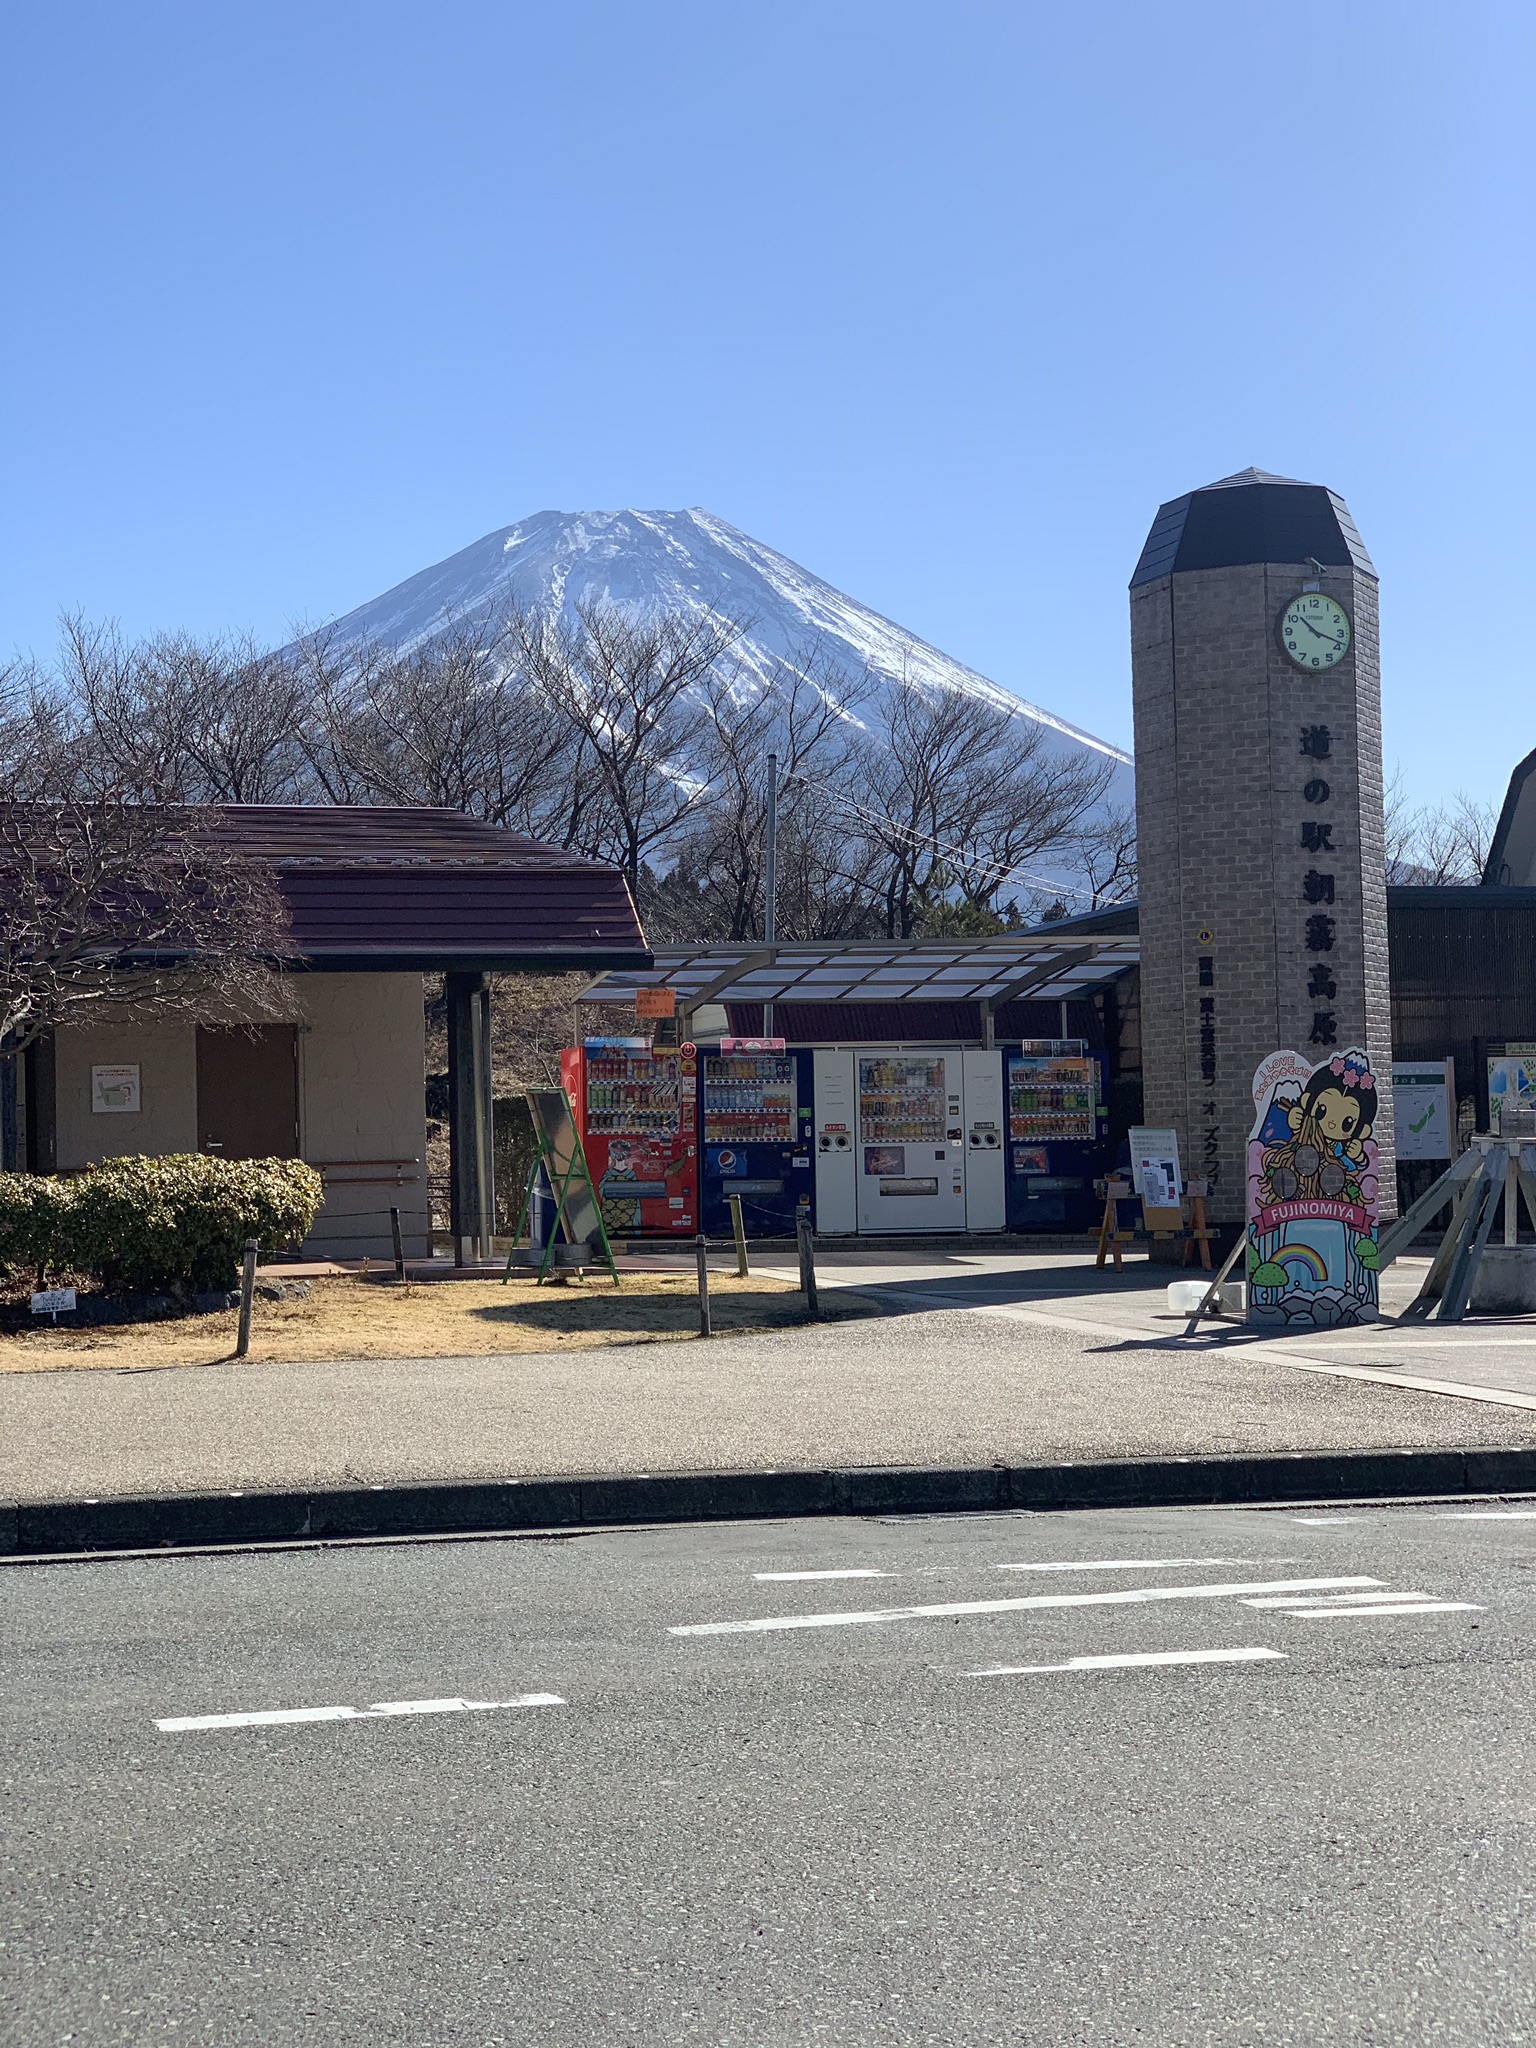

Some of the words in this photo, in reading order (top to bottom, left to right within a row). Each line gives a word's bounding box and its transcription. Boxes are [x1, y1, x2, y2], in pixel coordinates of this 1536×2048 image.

[1296, 603, 1306, 613] 11
[1309, 599, 1320, 609] 12
[1287, 614, 1299, 623] 10
[1333, 615, 1340, 624] 2
[1284, 627, 1293, 636] 9
[1336, 629, 1345, 638] 3
[1288, 641, 1297, 650] 8
[1332, 643, 1341, 651] 4
[1298, 652, 1307, 661] 7
[1325, 653, 1334, 662] 5
[1311, 657, 1320, 666] 6
[1265, 1056, 1295, 1073] LOVE
[1270, 1202, 1355, 1222] FUJINOMIYA
